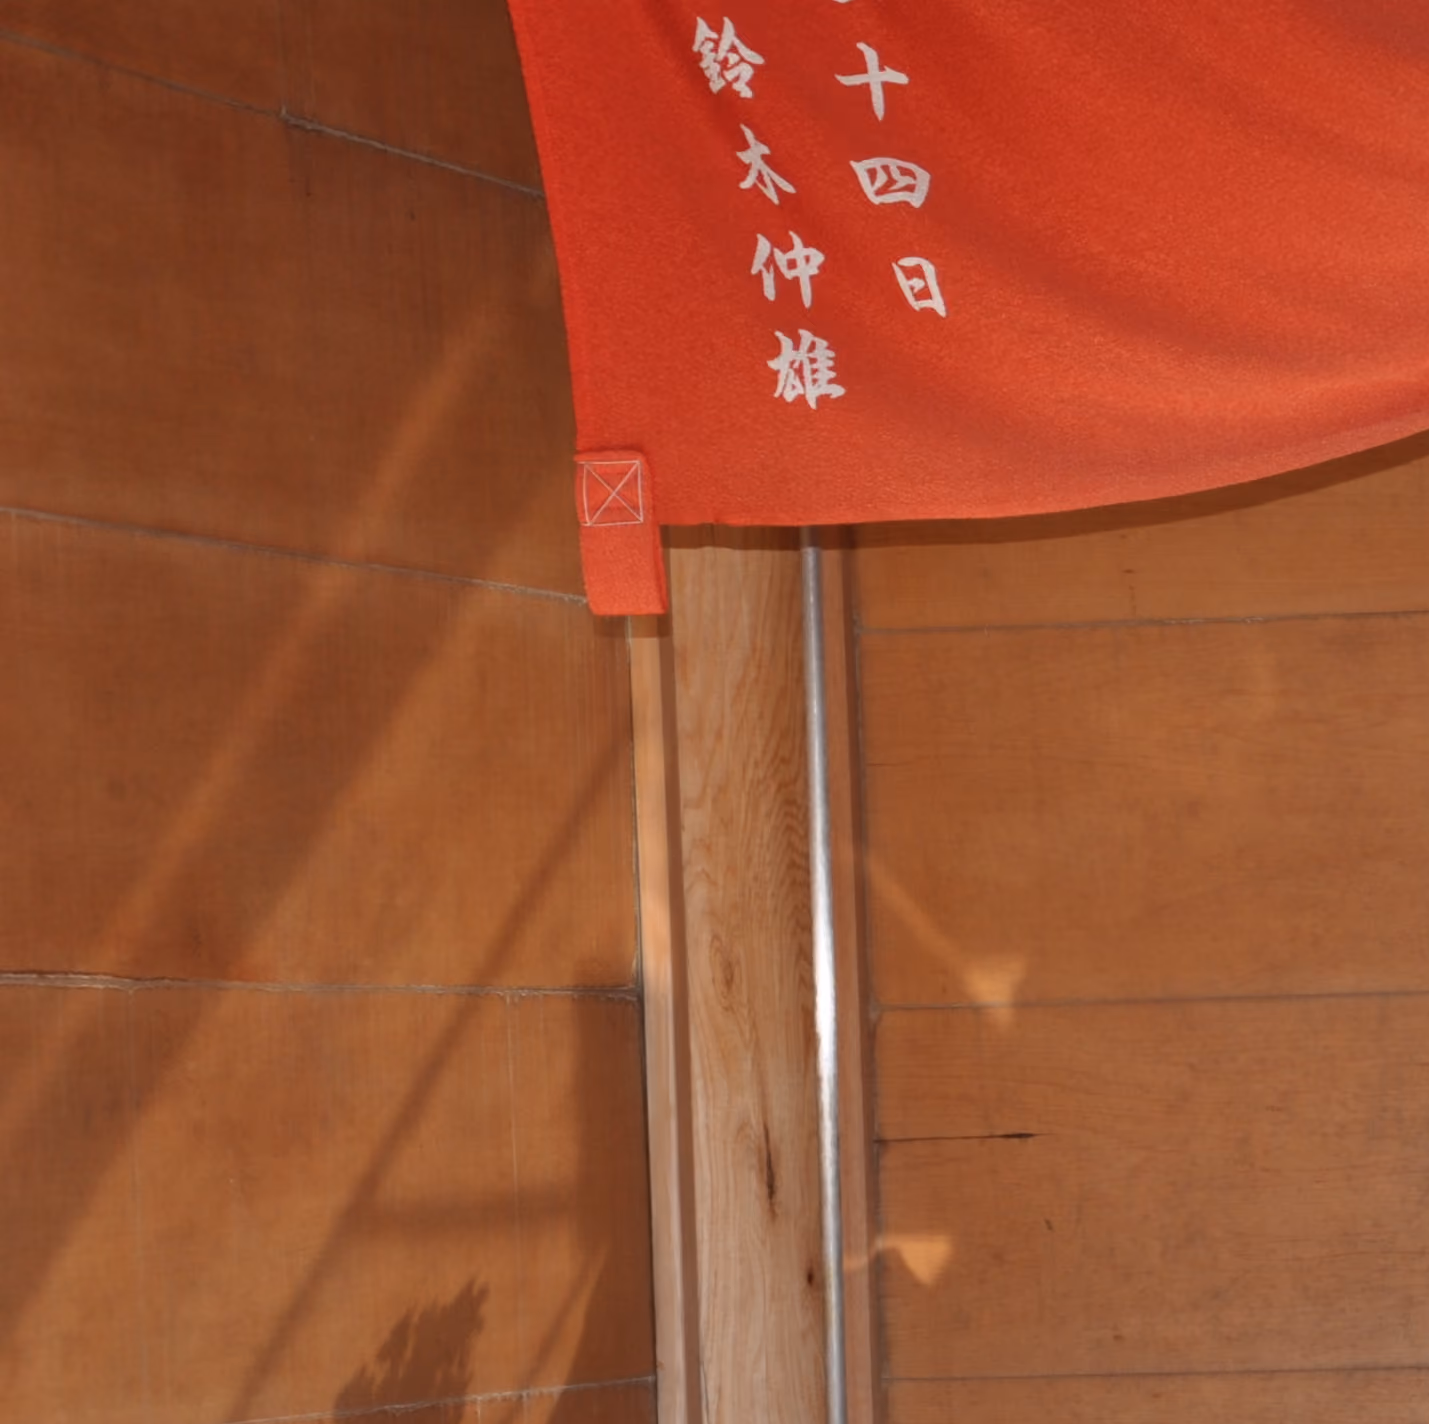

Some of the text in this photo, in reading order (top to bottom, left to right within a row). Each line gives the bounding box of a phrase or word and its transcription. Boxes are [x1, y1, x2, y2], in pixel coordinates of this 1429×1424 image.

[692, 17, 845, 409] 鈴木仲雄
[835, 43, 946, 317] 十四日
